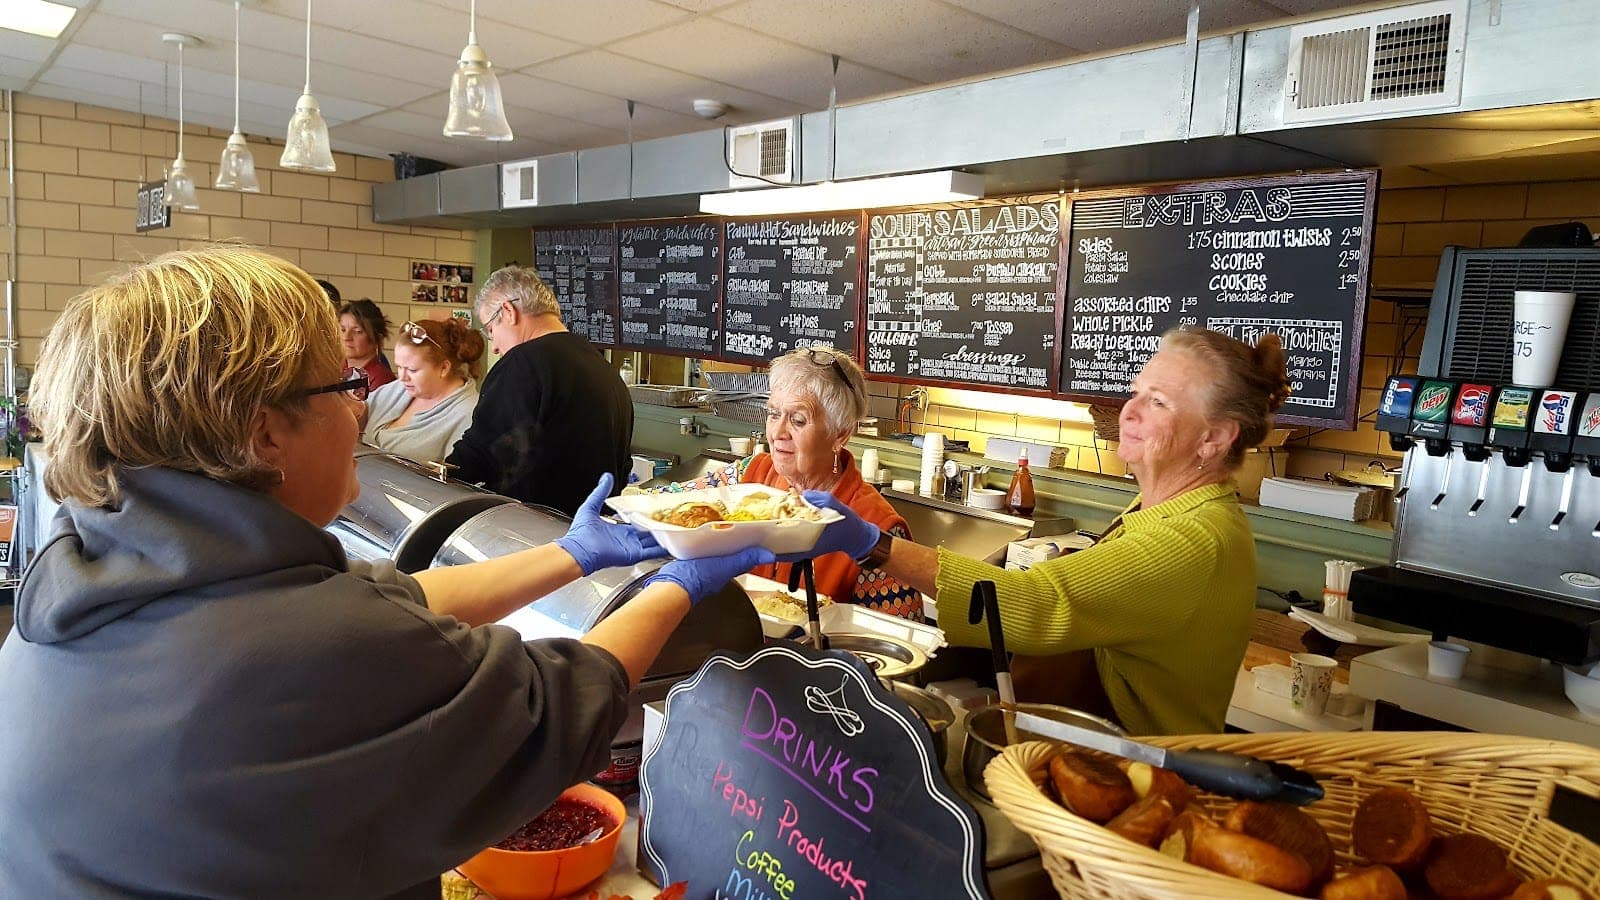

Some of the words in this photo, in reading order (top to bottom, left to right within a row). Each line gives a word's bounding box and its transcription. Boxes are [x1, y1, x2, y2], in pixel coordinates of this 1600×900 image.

[871, 213, 924, 239] SOUP
[934, 203, 1060, 236] SALADS
[1122, 187, 1292, 229] EXTRAS
[726, 222, 759, 239] Panini
[781, 217, 860, 238] Sandwiches
[1078, 236, 1113, 254] Sides
[1212, 229, 1281, 250] cinnamon
[1210, 252, 1265, 271] scones
[942, 345, 1026, 366] dressings
[1070, 333, 1105, 350] Ready
[1383, 379, 1399, 414] PEPSI
[1473, 390, 1489, 425] PEPSI
[1554, 395, 1570, 433] PEPSI
[741, 687, 879, 813] DRINKS
[711, 759, 766, 822] Pepsi
[776, 799, 868, 900] Products
[735, 830, 796, 900] Coffee
